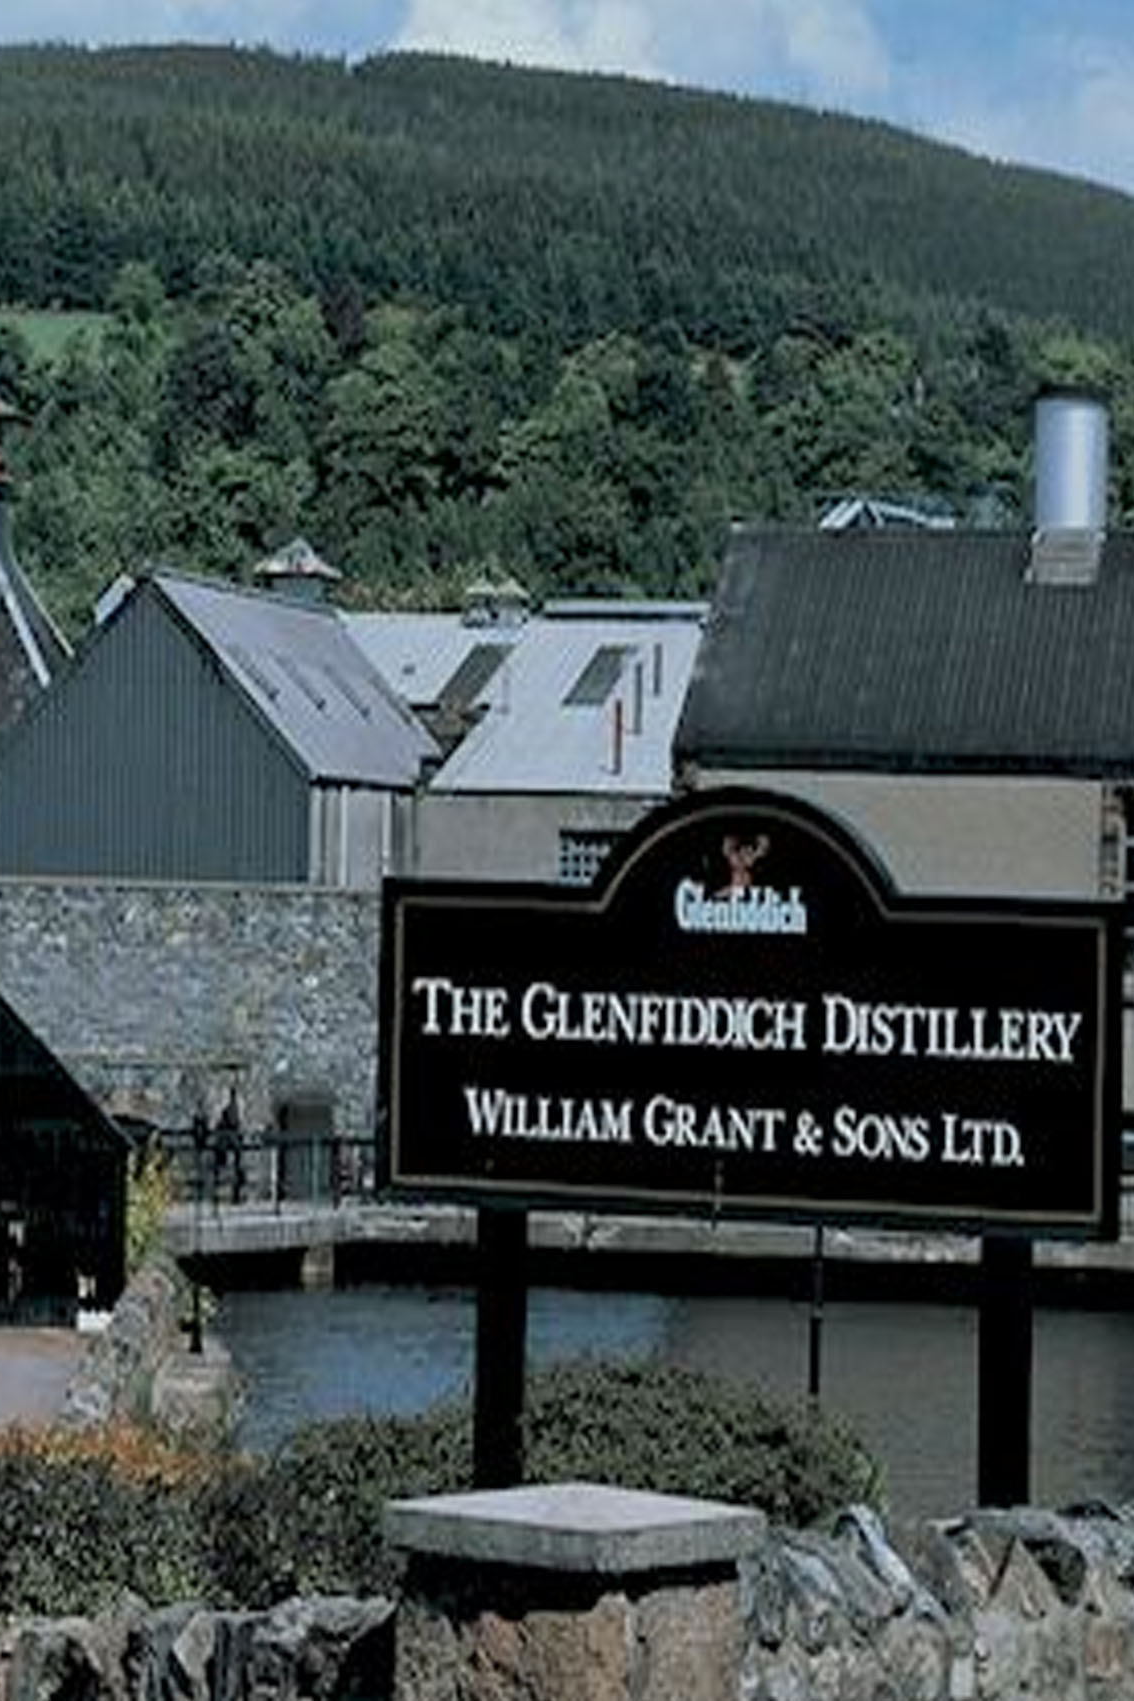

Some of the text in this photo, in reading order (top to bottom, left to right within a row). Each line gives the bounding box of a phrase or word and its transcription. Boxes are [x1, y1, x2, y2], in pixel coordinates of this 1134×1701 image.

[675, 878, 807, 935] Glenfiddich
[413, 978, 1082, 1062] THE GLENFIDDICH DISTILLERY
[465, 1088, 1025, 1165] WILLIAM GRANT & SONS LTD.
